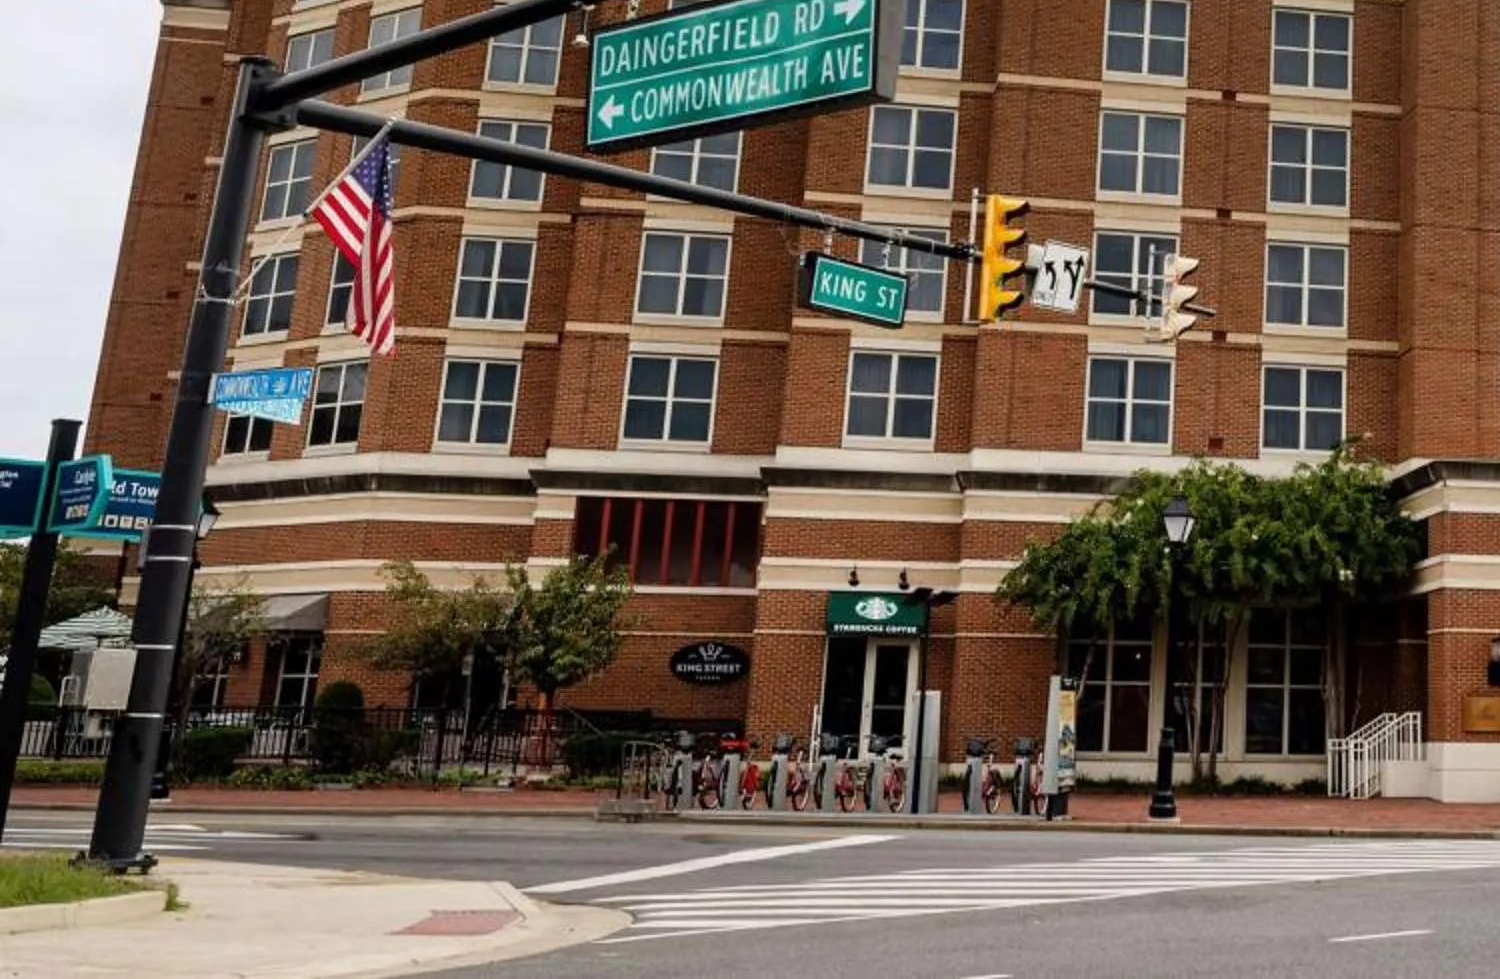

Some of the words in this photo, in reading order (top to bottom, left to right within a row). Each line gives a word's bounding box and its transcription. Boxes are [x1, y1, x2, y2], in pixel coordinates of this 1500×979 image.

[600, 11, 780, 77] DAINGERFIELD
[631, 56, 809, 123] COMMONWEALTH
[820, 43, 865, 86] AVE
[820, 271, 867, 302] KING
[876, 285, 898, 310] ST
[110, 480, 126, 495] ld
[130, 482, 160, 498] Tow
[833, 624, 883, 633] STARBUCKS
[885, 625, 917, 634] COFFEE
[676, 663, 702, 673] KING
[703, 663, 740, 674] STREET
